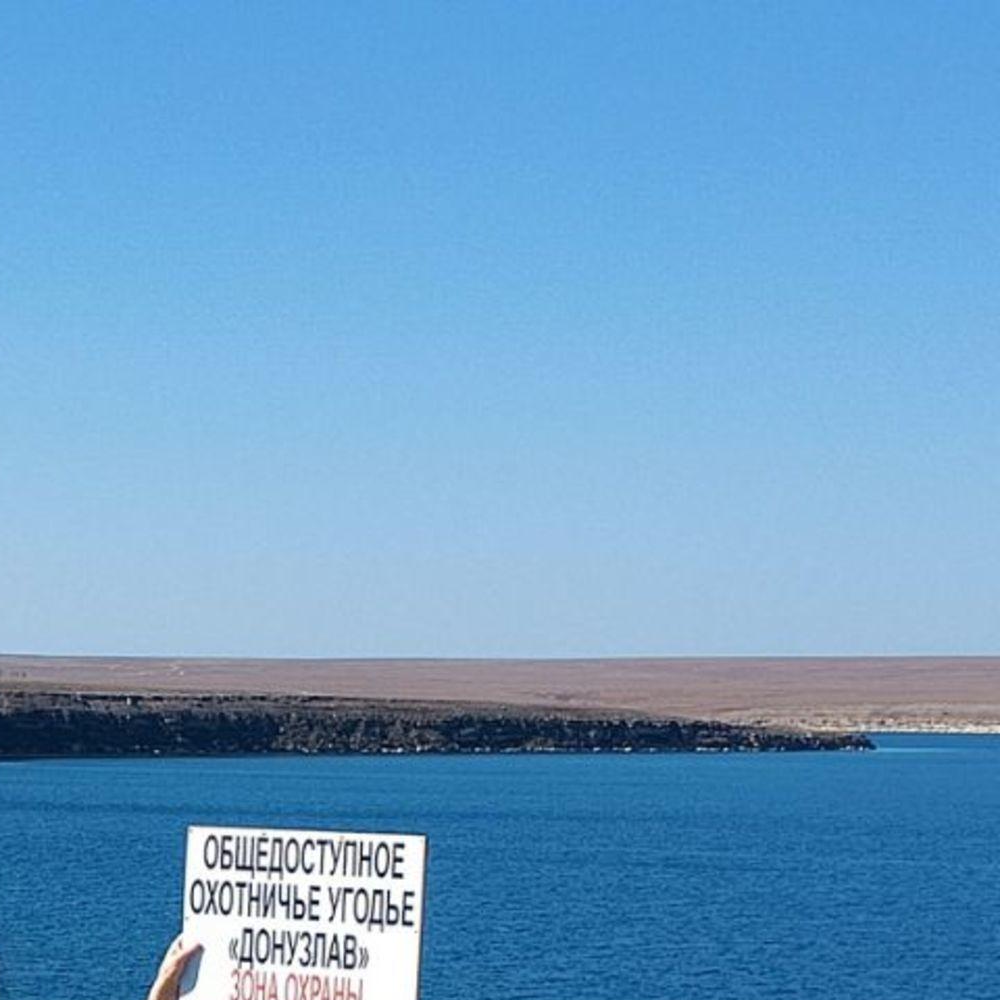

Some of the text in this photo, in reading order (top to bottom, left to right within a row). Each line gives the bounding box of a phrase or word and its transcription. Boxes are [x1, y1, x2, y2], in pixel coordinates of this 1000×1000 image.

[203, 834, 405, 880] ОБЩЕДОСТУПНОЕ
[190, 879, 415, 932] ОХОТНИЧЬЕ УГОДЬЕ
[229, 928, 369, 970] «ДОНУЗЛАВ»
